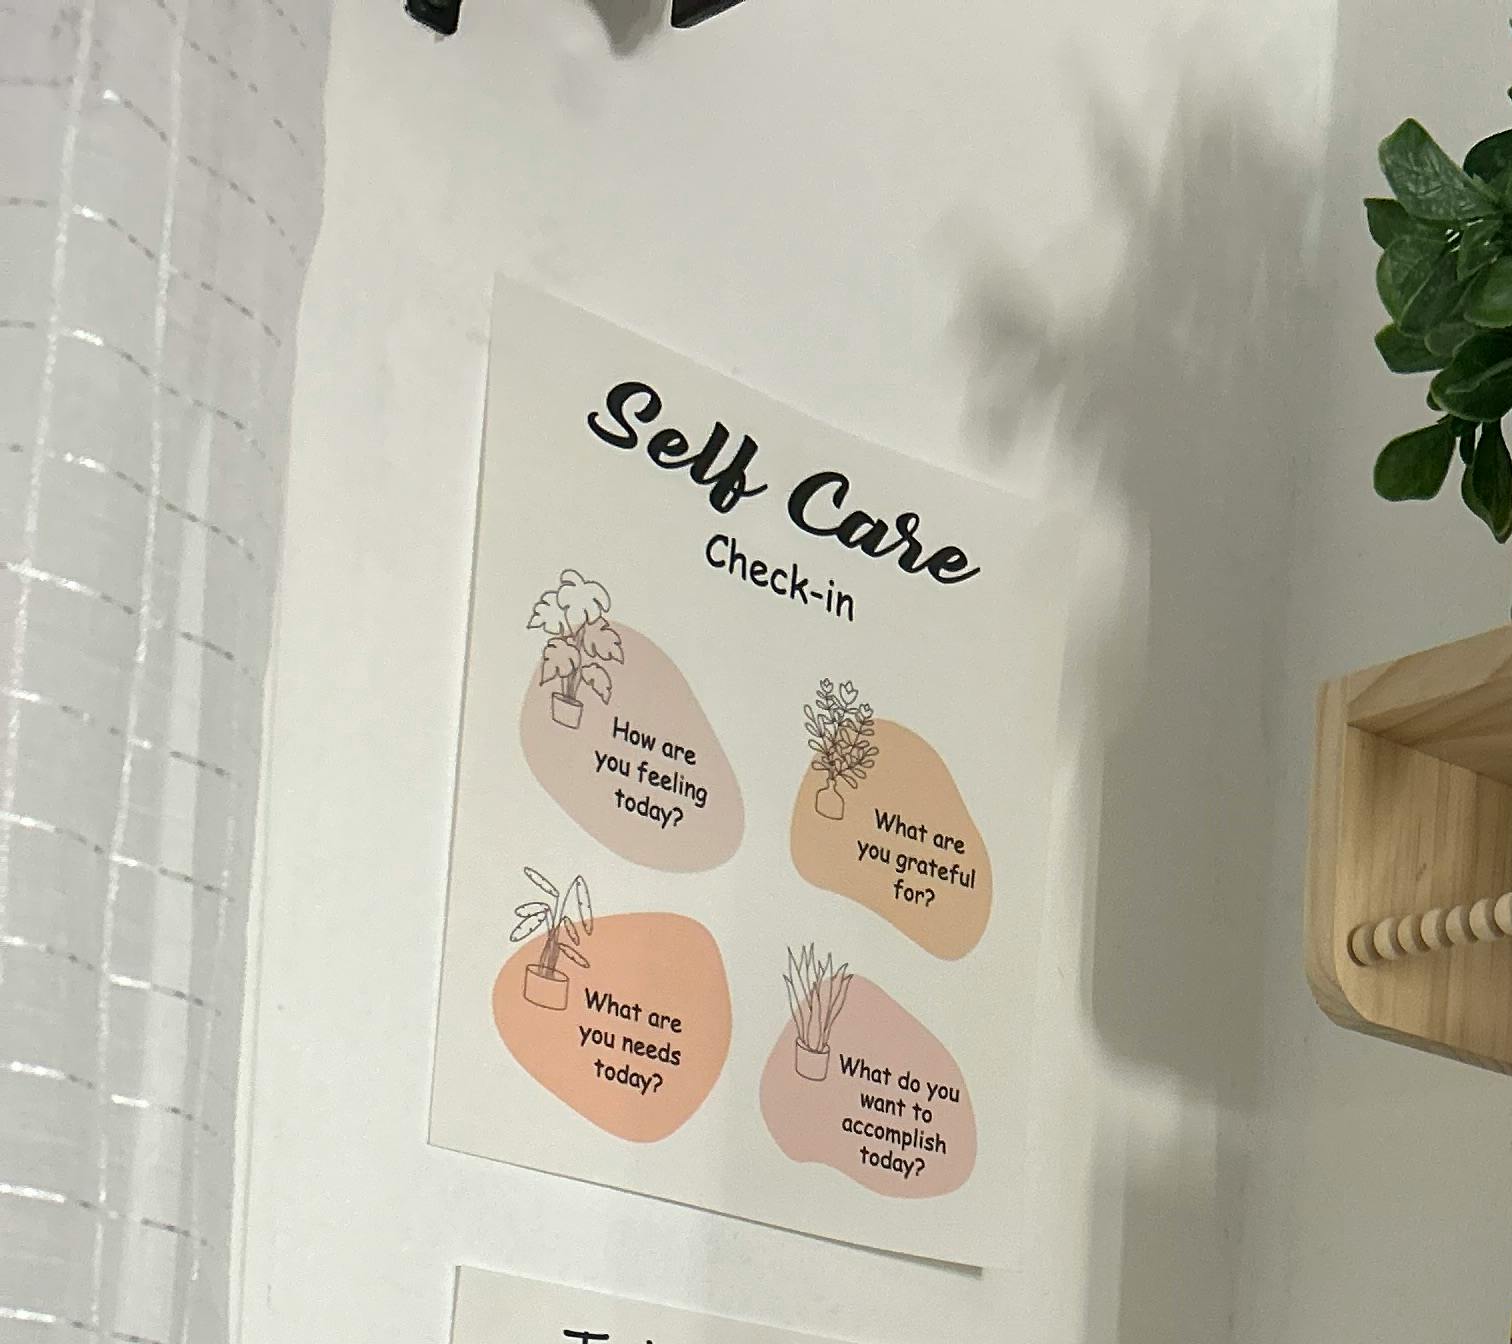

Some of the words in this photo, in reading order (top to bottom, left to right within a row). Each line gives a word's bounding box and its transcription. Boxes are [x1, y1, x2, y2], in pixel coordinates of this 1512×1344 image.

[587, 381, 768, 513] Self
[787, 471, 980, 584] Care
[705, 534, 855, 622] Check-in
[612, 717, 656, 752] How
[661, 739, 697, 765] are
[594, 748, 631, 782] you
[637, 762, 708, 807] feeling
[615, 788, 684, 829] today?
[875, 808, 926, 843] What
[931, 829, 966, 854] are
[856, 838, 890, 868] you
[894, 849, 976, 890] grateful
[892, 878, 935, 908] for?
[585, 988, 642, 1023] What
[647, 1007, 683, 1034] are
[578, 1023, 616, 1052] you
[622, 1034, 682, 1066] needs
[593, 1059, 663, 1095] today?
[839, 1053, 892, 1087] What
[897, 1070, 920, 1094] do
[924, 1081, 961, 1104] you
[860, 1092, 905, 1117] want
[910, 1101, 933, 1124] to
[841, 1116, 947, 1156] accomplish
[860, 1145, 925, 1177] today?
